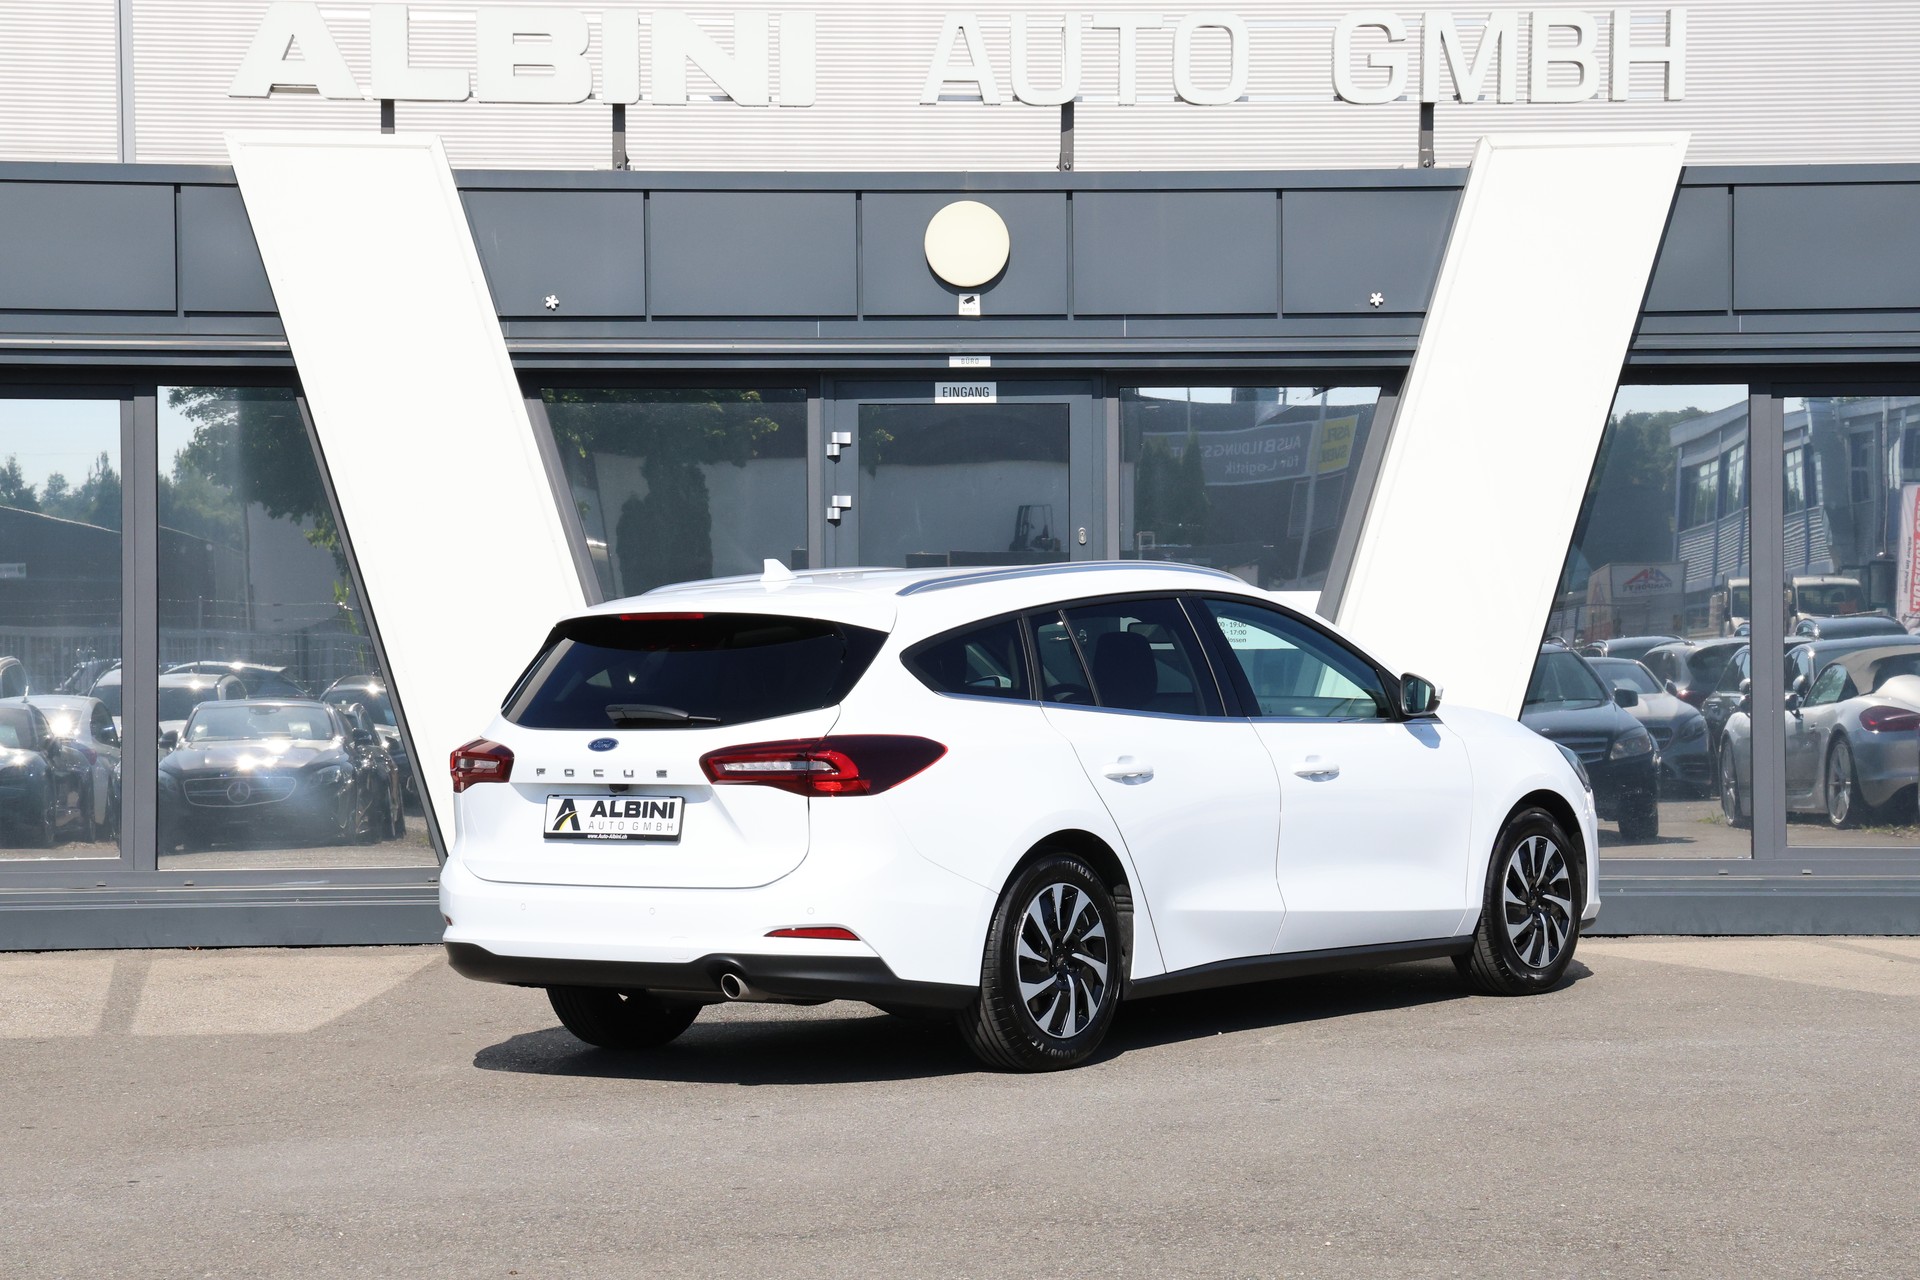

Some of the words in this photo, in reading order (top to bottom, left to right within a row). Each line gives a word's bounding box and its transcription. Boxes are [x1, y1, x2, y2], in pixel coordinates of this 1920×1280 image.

[227, 1, 817, 107] ALBINI
[919, 9, 1251, 106] AUTO
[1332, 8, 1688, 105] GMBH
[960, 356, 980, 365] BÜRO
[942, 386, 990, 398] EINGANG
[536, 768, 668, 778] FOCUS
[590, 800, 676, 819] ALBINI
[588, 820, 625, 832] AUTO
[632, 821, 674, 832] GMBH
